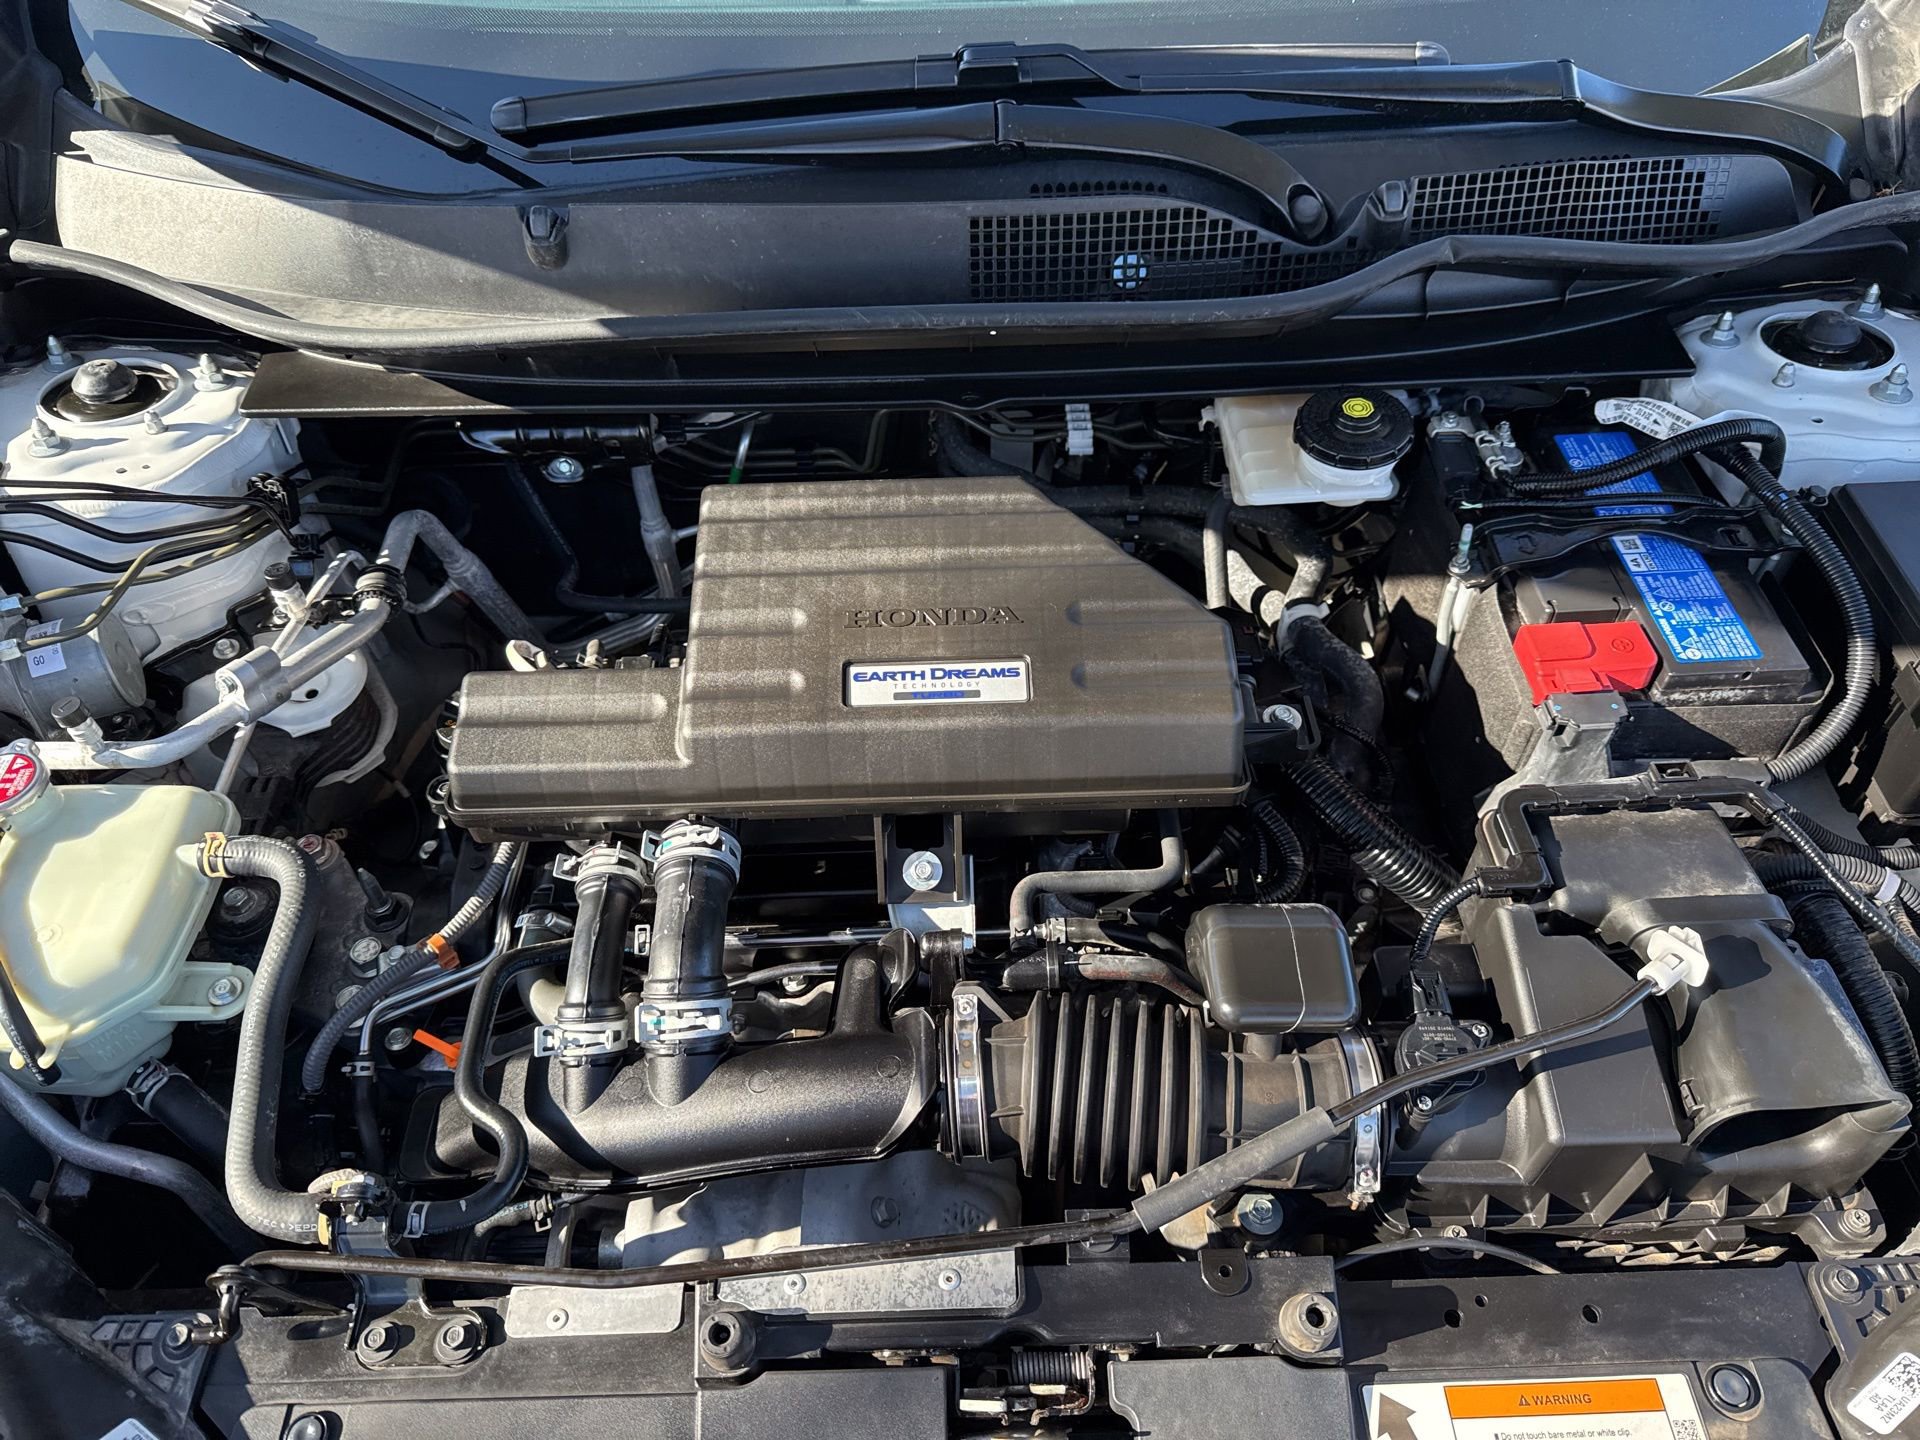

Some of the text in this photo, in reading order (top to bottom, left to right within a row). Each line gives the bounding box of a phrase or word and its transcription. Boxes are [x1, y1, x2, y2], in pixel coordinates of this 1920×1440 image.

[843, 606, 1025, 628] HONDA
[853, 667, 1021, 682] EARTH DREAMS
[893, 681, 981, 689] TECHNOLOGY
[1532, 1393, 1592, 1406] WARNING
[1501, 1432, 1511, 1440] Do
[1513, 1431, 1525, 1440] not
[1526, 1431, 1546, 1440] touch
[1548, 1430, 1564, 1439] bare
[1566, 1430, 1585, 1438] metal
[1596, 1428, 1616, 1437] white
